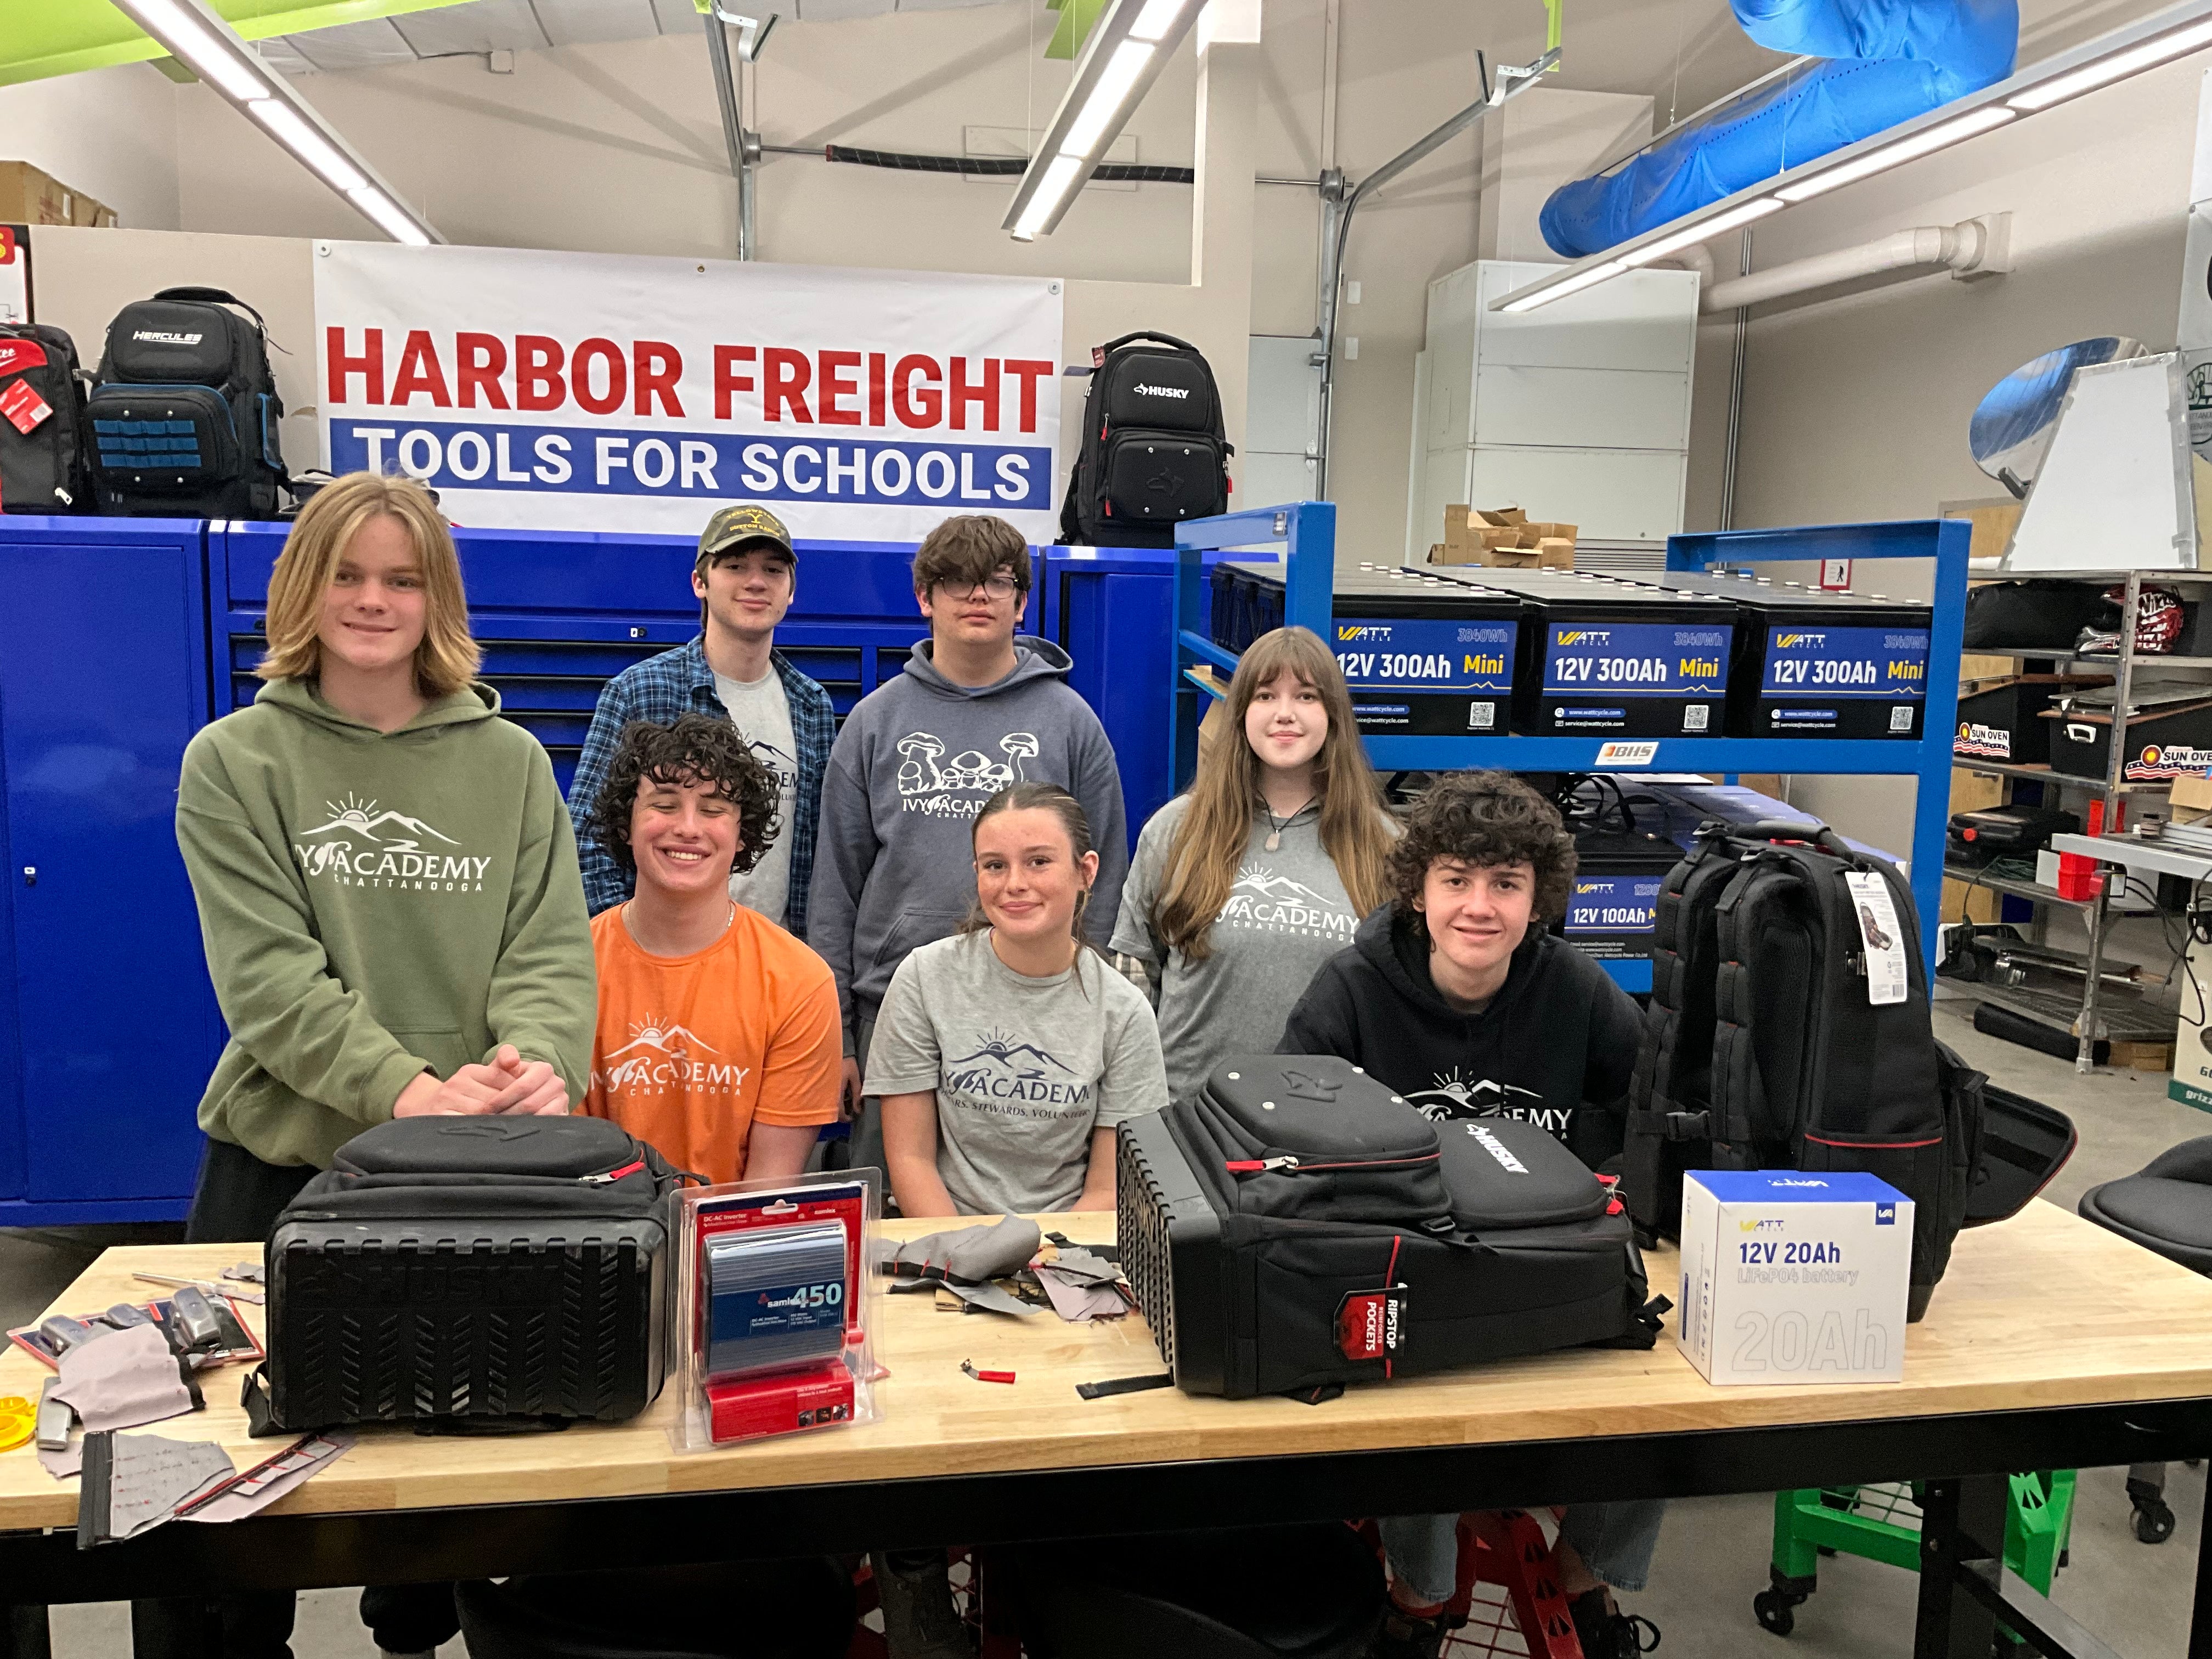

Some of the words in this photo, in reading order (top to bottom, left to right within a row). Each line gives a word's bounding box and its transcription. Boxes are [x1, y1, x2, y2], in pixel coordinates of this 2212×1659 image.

[133, 331, 202, 342] HERCULES
[326, 326, 686, 418] HARBOR
[714, 344, 1053, 433] FREIGHT
[1148, 385, 1189, 399] HUSKY
[353, 427, 572, 483] TOOLS
[596, 437, 720, 490] FOR
[741, 443, 1030, 501] SCHOOLS
[1338, 626, 1392, 640] WATT
[1457, 628, 1508, 643] 3840Wh
[1557, 631, 1610, 645] WATT
[1673, 631, 1723, 646] 3840Wh
[1776, 634, 1825, 648] WATT
[1337, 653, 1375, 677] 12V
[1379, 653, 1451, 678] 300Ah
[1463, 654, 1504, 674] Mini
[1555, 658, 1593, 681] 12V
[1597, 658, 1667, 682] 300Ah
[1679, 657, 1719, 677] Mini
[1774, 660, 1809, 682] 12V
[1812, 660, 1876, 684] 300Ah
[1887, 660, 1924, 679] Mini
[1971, 729, 1986, 738] SUN
[1988, 731, 2008, 741] OVEN
[2163, 751, 2188, 761] SUN
[2191, 752, 2212, 761] OVE
[902, 798, 928, 812] IVY
[938, 798, 989, 814] ACAD
[334, 850, 492, 880] ACADEMY
[334, 873, 482, 891] CHATTANOOGA
[1577, 883, 1615, 894] WATT
[1634, 883, 1661, 896] 1280
[1234, 901, 1360, 934] ACADEMY
[1573, 908, 1599, 923] 12V
[1602, 907, 1645, 923] 100Ah
[1233, 920, 1356, 944] CHATTANOOGA
[630, 1081, 741, 1096] CHATNOOGA
[970, 1076, 1090, 1104] ACADEM
[2186, 1090, 2212, 1105] grizz
[972, 1099, 1028, 1117] STEWARDS.
[1475, 1135, 1529, 1173] HUSKY
[1739, 1219, 1785, 1232] WATT
[1739, 1242, 1778, 1264] 12V
[1784, 1241, 1841, 1264] 20Ah
[1802, 1267, 1860, 1286] battery
[792, 1283, 842, 1308] 450
[1365, 1301, 1377, 1352] POCKETS
[1386, 1299, 1398, 1350] RIPSTOP
[1731, 1308, 1887, 1372] 20Ah
